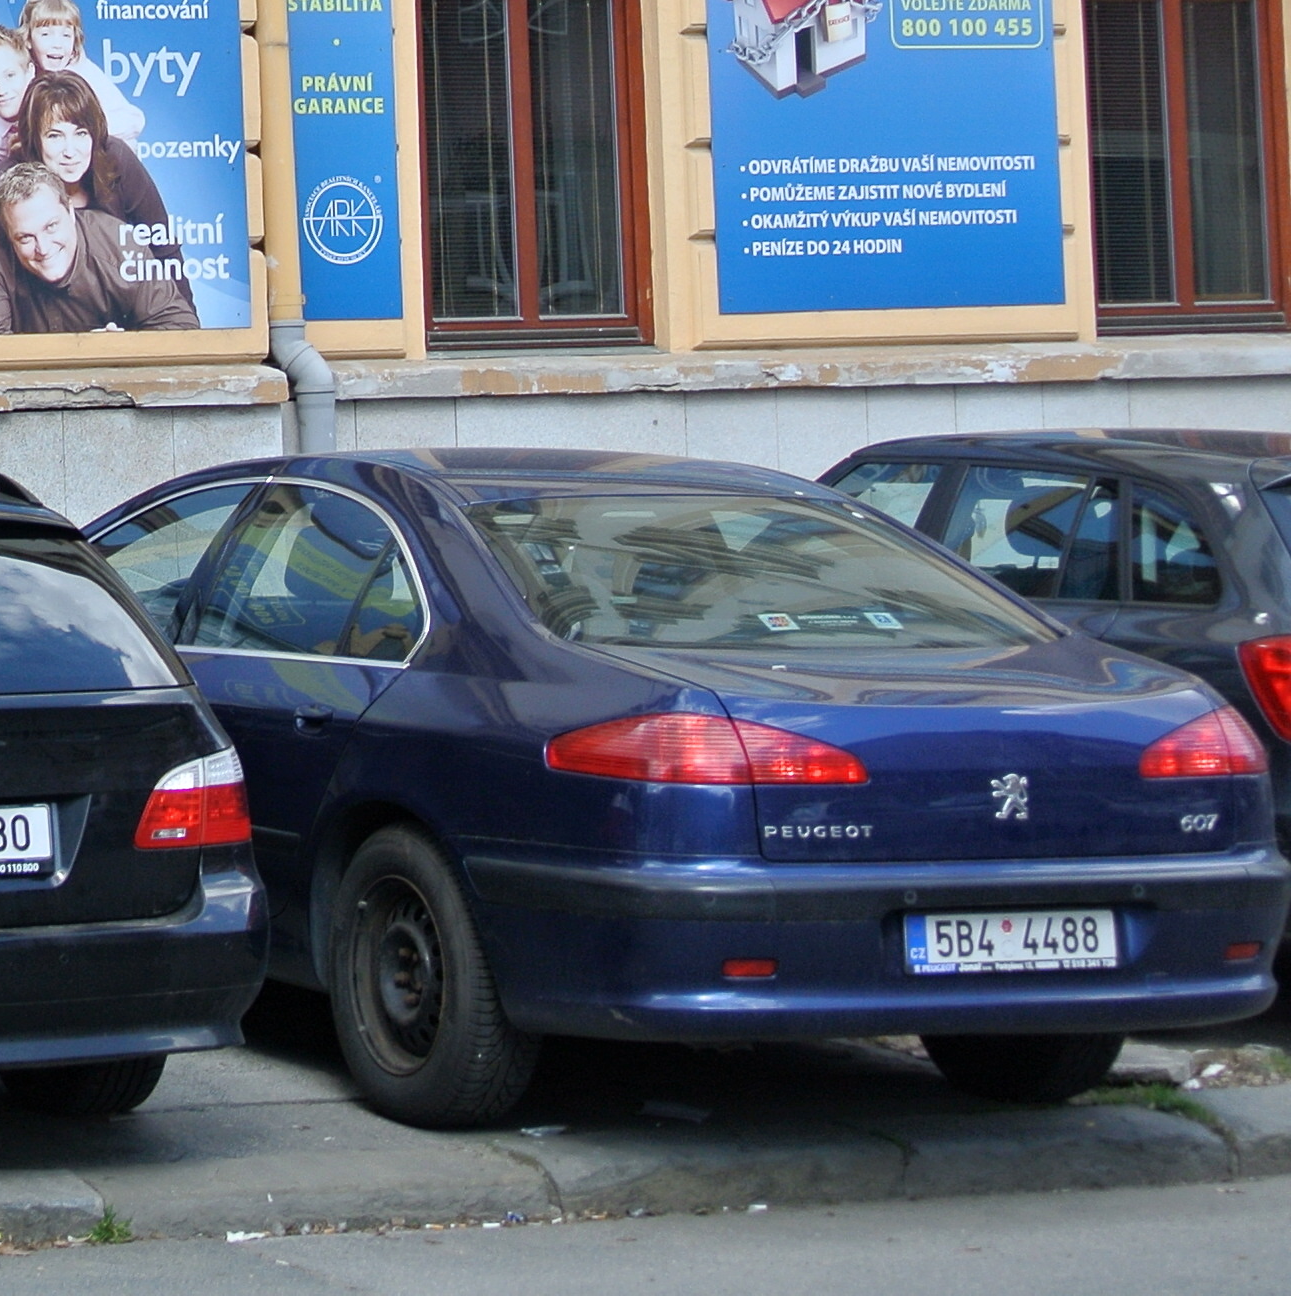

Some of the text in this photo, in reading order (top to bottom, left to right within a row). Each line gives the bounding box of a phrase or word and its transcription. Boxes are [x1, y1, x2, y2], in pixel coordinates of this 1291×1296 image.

[902, 18, 1033, 37] 800 100 455
[102, 38, 202, 97] byty
[302, 72, 373, 93] PRÁVNÍ
[293, 97, 385, 115] GARANCE
[136, 134, 242, 164] pozemky
[748, 154, 1036, 175] ODVRÁTÍME DRAŽBU VAŠÍ NEMOVITOSTI
[750, 180, 1007, 202] POMŮŽEME ZAJISTIT NOVÉ BYDLENÍ
[317, 198, 367, 237] ARK
[750, 208, 1018, 230] OKAMŽITÝ VÝKUP VAŠÍ NEMOVITOSTI
[119, 214, 225, 247] realitní
[752, 238, 903, 257] PENÍZE DO 24 HODIN
[119, 250, 230, 282] činnost
[763, 824, 874, 839] PEUGEOT
[1180, 814, 1219, 833] 607
[7, 862, 23, 873] 110
[23, 862, 40, 872] 800
[934, 915, 1100, 958] 5B4 4488
[910, 947, 927, 960] CZ
